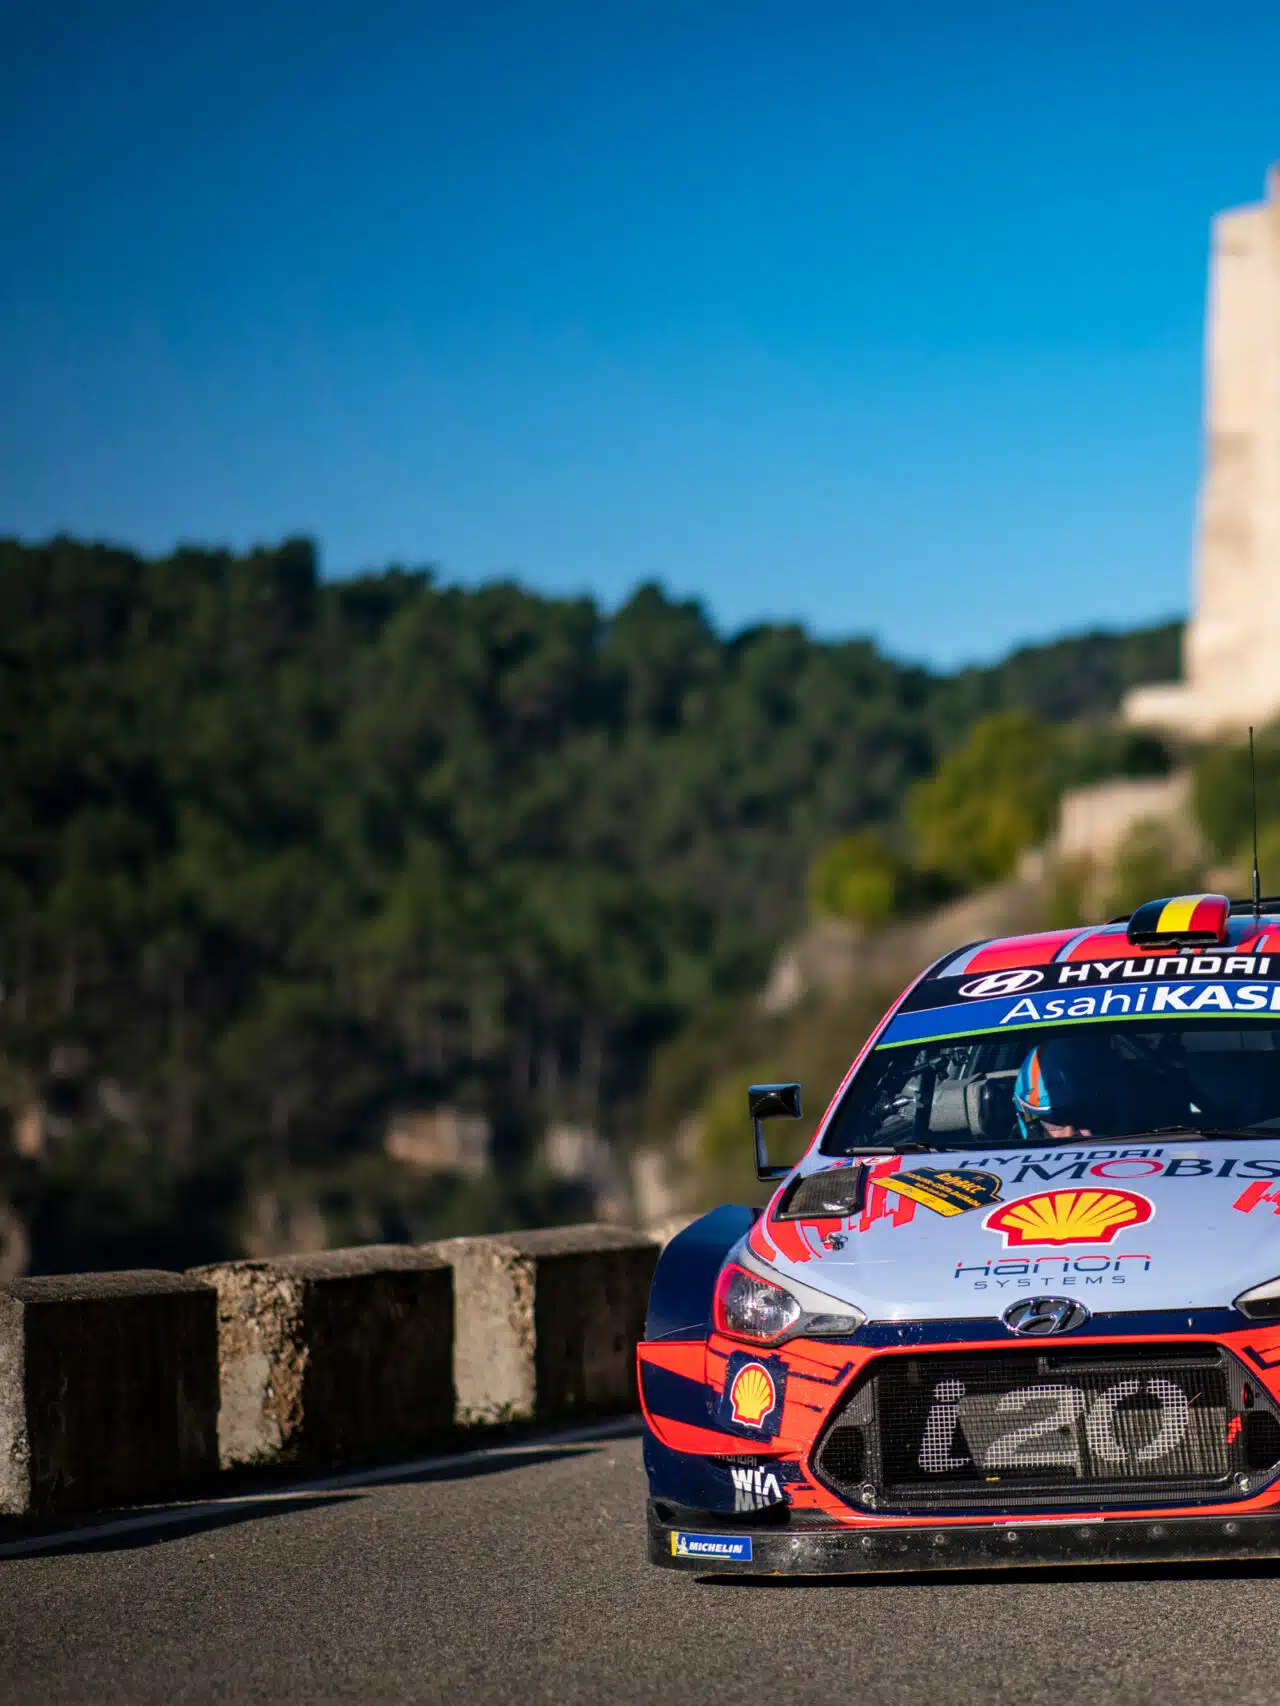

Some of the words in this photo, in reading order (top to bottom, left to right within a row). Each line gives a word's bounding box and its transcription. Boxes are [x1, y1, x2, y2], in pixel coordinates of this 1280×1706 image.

[1058, 956, 1271, 984] HYUNDAI
[958, 1148, 1164, 1169] HYUNDAI
[973, 1275, 1127, 1290] SYSTEMS
[688, 1541, 744, 1554] MICHELIN
